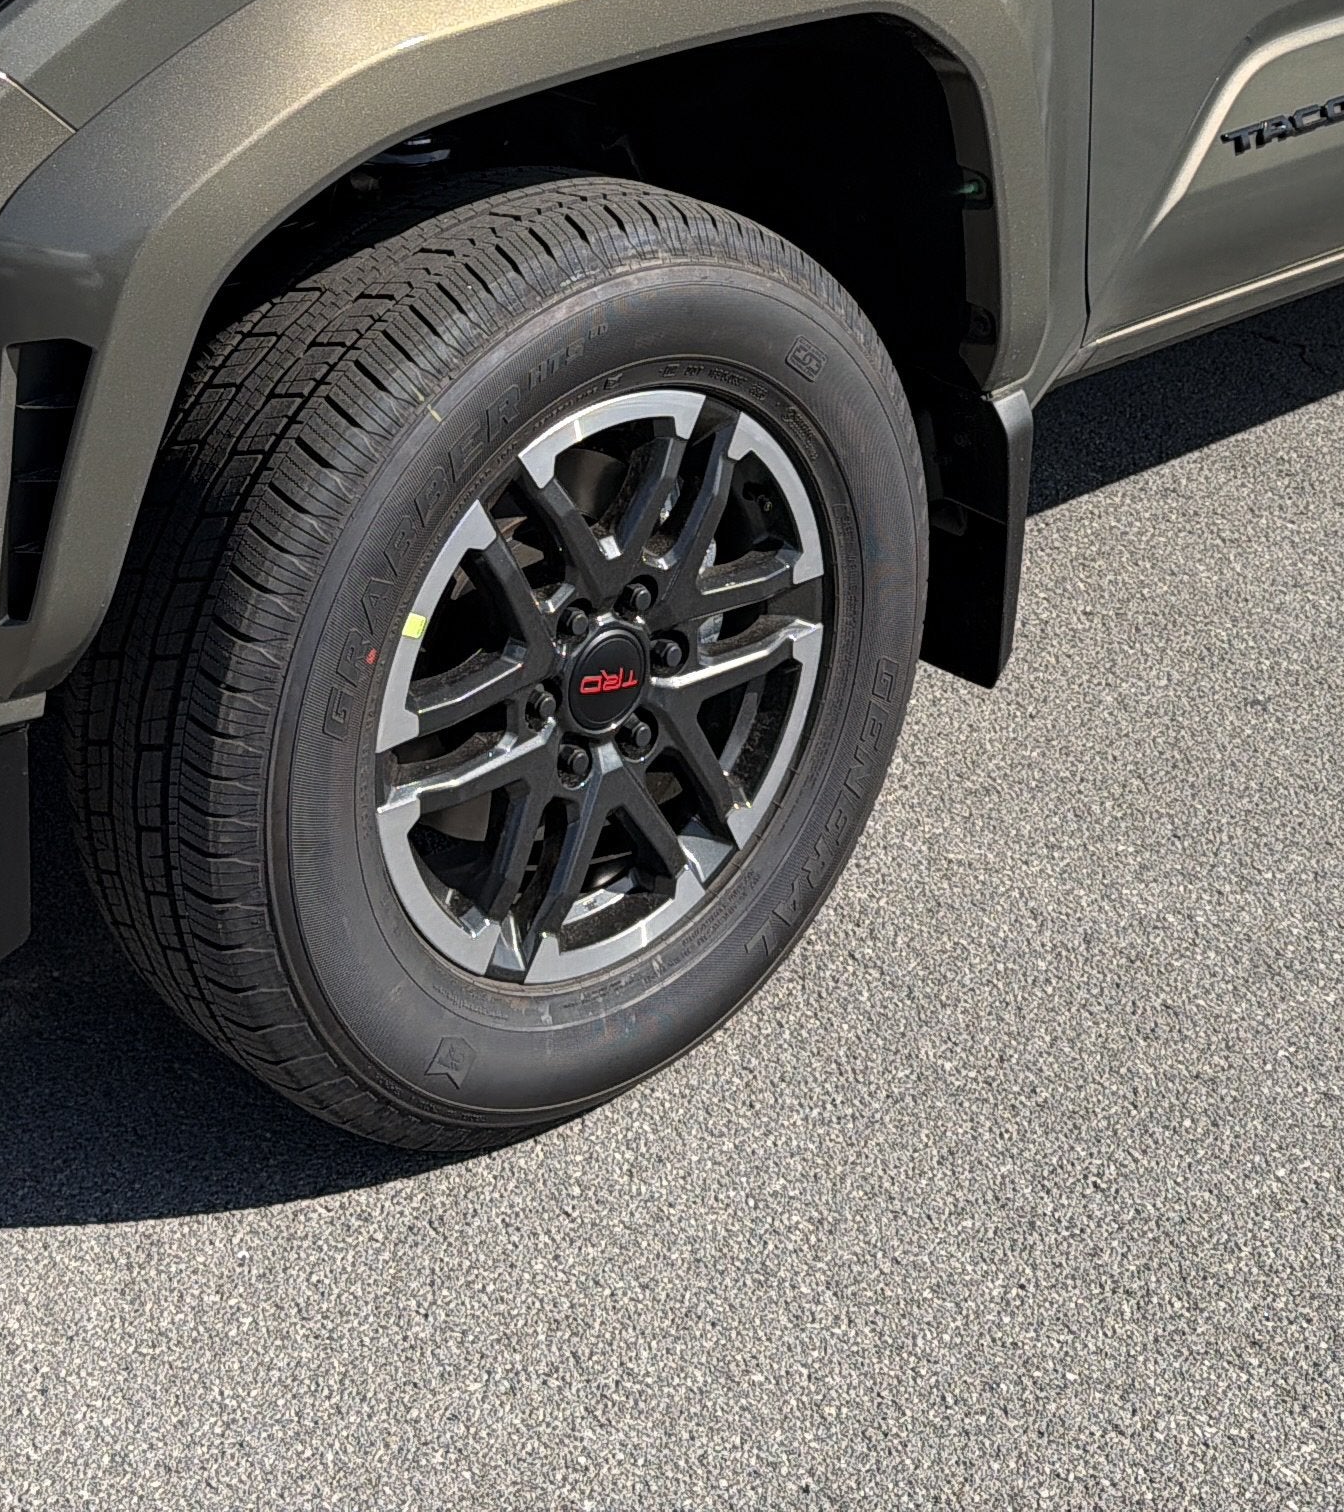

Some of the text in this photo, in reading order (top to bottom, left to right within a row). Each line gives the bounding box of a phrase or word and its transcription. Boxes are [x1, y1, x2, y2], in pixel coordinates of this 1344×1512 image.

[322, 384, 521, 742] GRABBER
[580, 668, 639, 695] TRD
[744, 655, 901, 957] GENERAL
